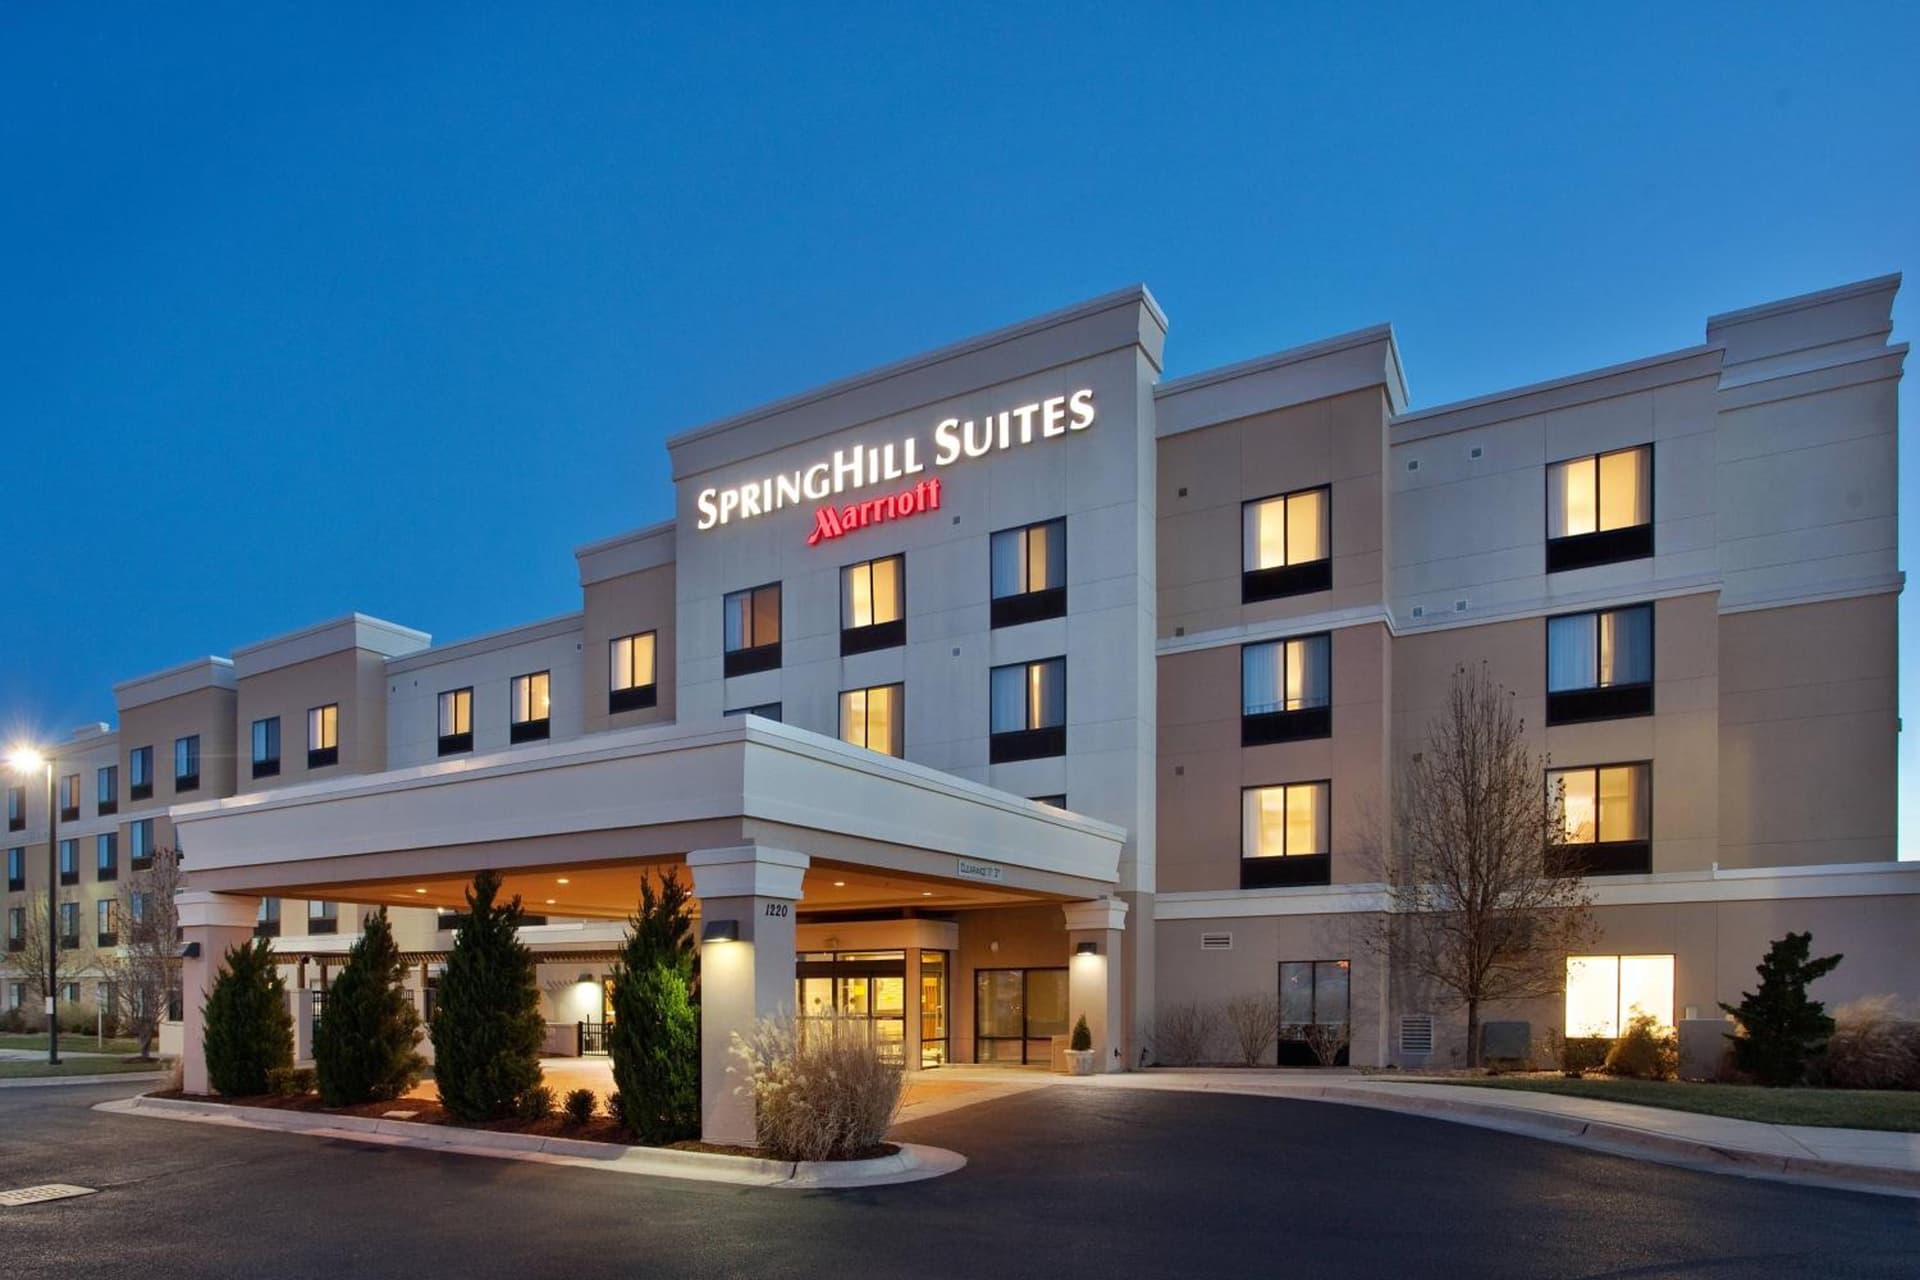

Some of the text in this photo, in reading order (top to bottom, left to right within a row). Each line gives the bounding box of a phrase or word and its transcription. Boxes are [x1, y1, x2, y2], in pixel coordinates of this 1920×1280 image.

[697, 388, 1096, 530] SPRINGHILL SUITES
[807, 478, 942, 545] Marriott
[766, 903, 788, 918] 1220
